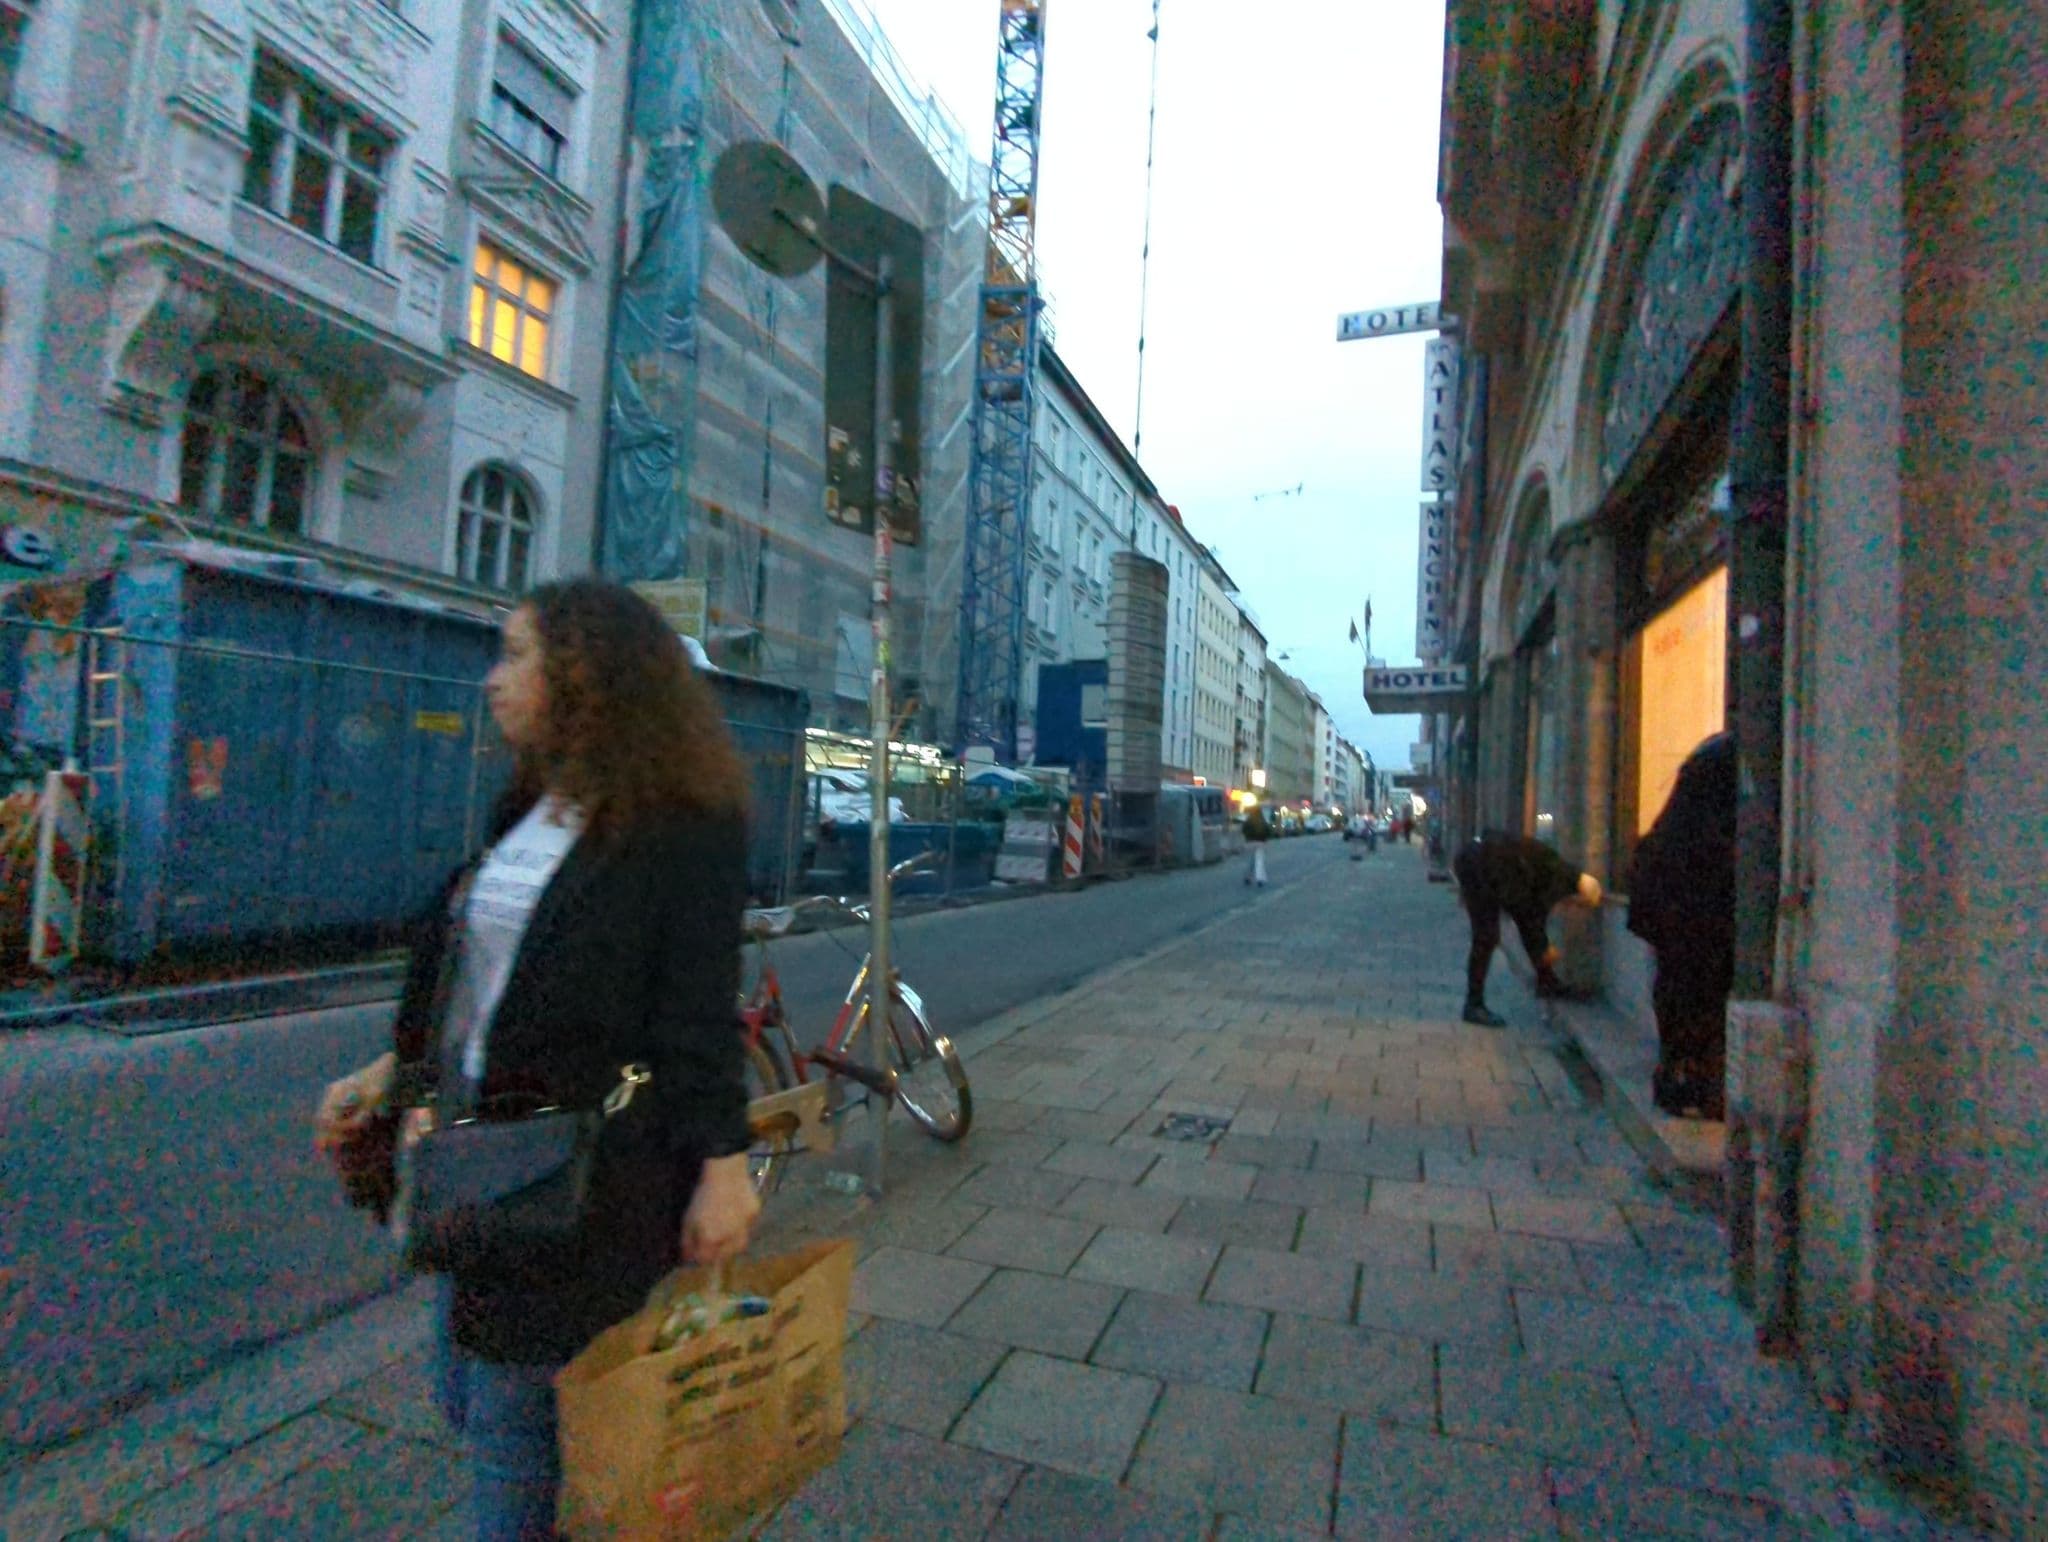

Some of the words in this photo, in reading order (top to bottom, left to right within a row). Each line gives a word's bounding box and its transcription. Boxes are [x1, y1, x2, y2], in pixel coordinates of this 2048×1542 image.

[1343, 303, 1449, 334] HOTEL
[1428, 360, 1450, 484] ATLAS
[1372, 671, 1464, 689] HOTEL
